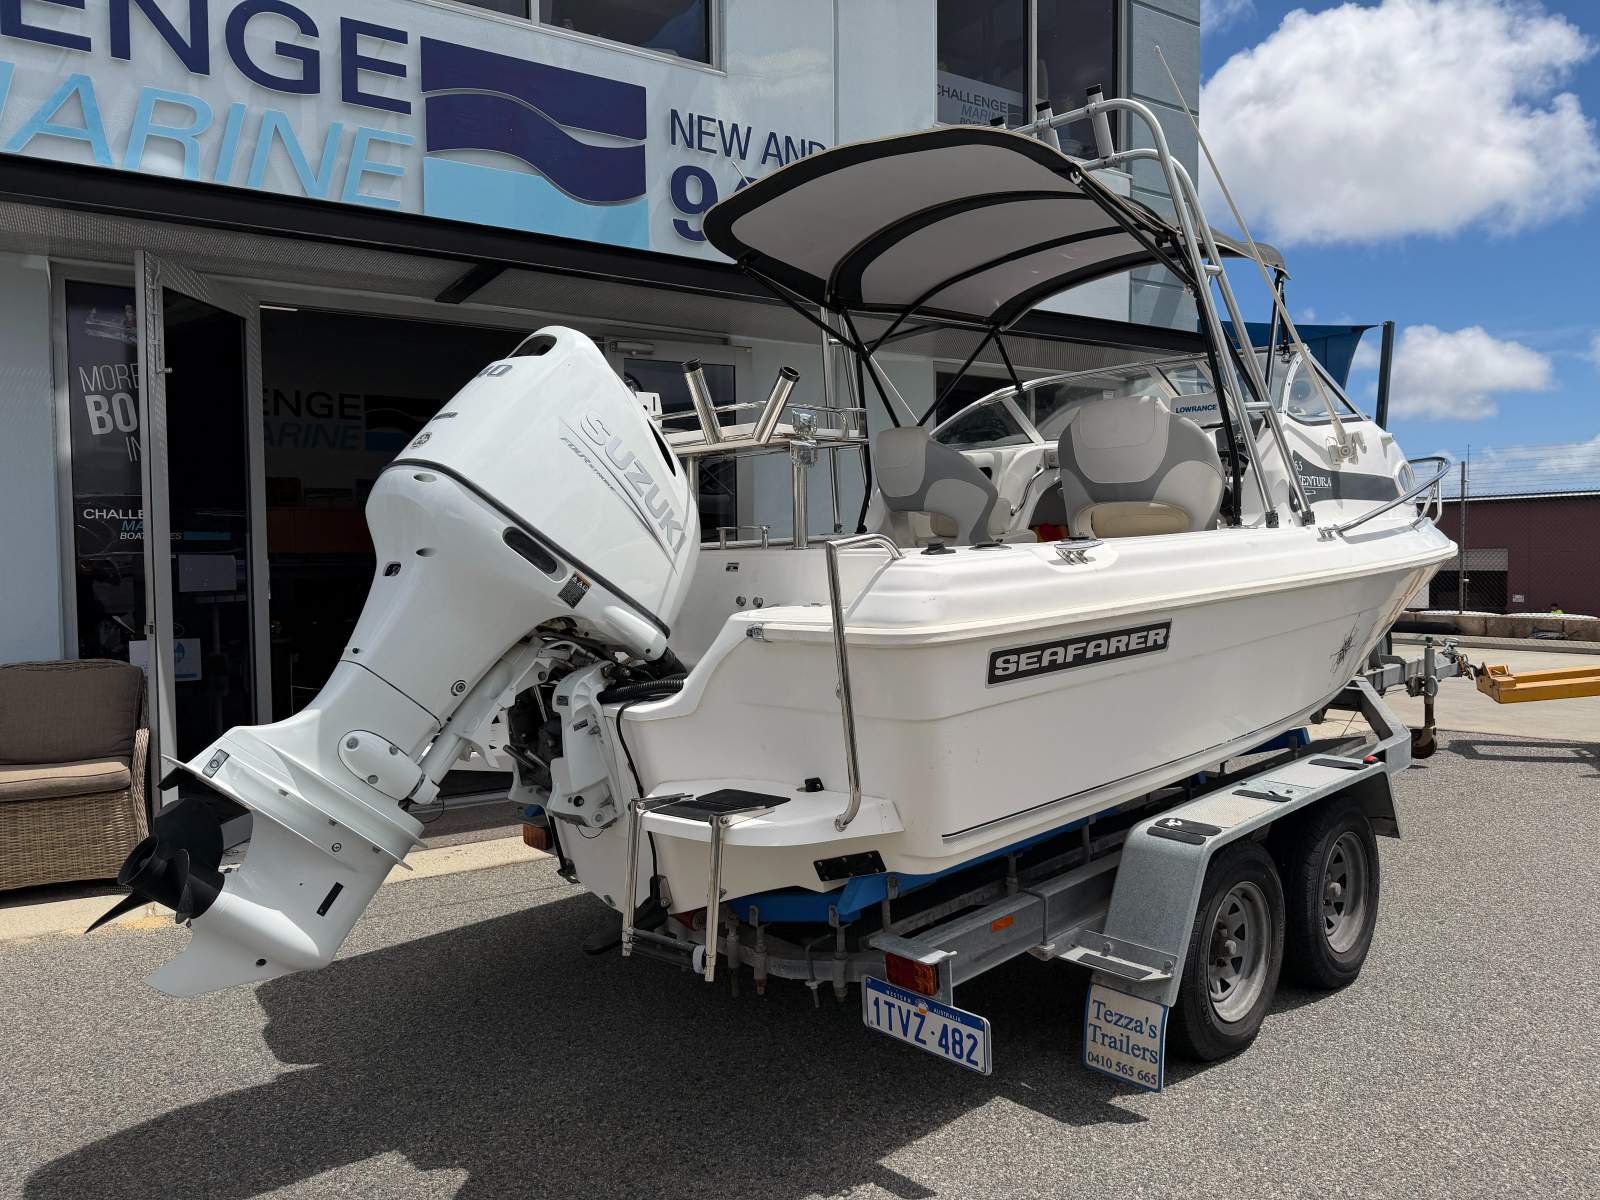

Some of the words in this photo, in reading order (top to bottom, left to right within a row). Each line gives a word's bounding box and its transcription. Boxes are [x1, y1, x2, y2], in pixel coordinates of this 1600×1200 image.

[0, 60, 416, 210] ARINE
[670, 108, 752, 162] NEW
[1175, 403, 1218, 414] LOWRANCE
[580, 409, 688, 555] SUZUKI
[994, 628, 1167, 676] SEAFARER
[1092, 999, 1158, 1039] Tezza's
[1089, 1023, 1158, 1065] Trailers
[1087, 1051, 1112, 1069] 0410
[1115, 1061, 1135, 1077] 565
[1137, 1069, 1157, 1085] 665
